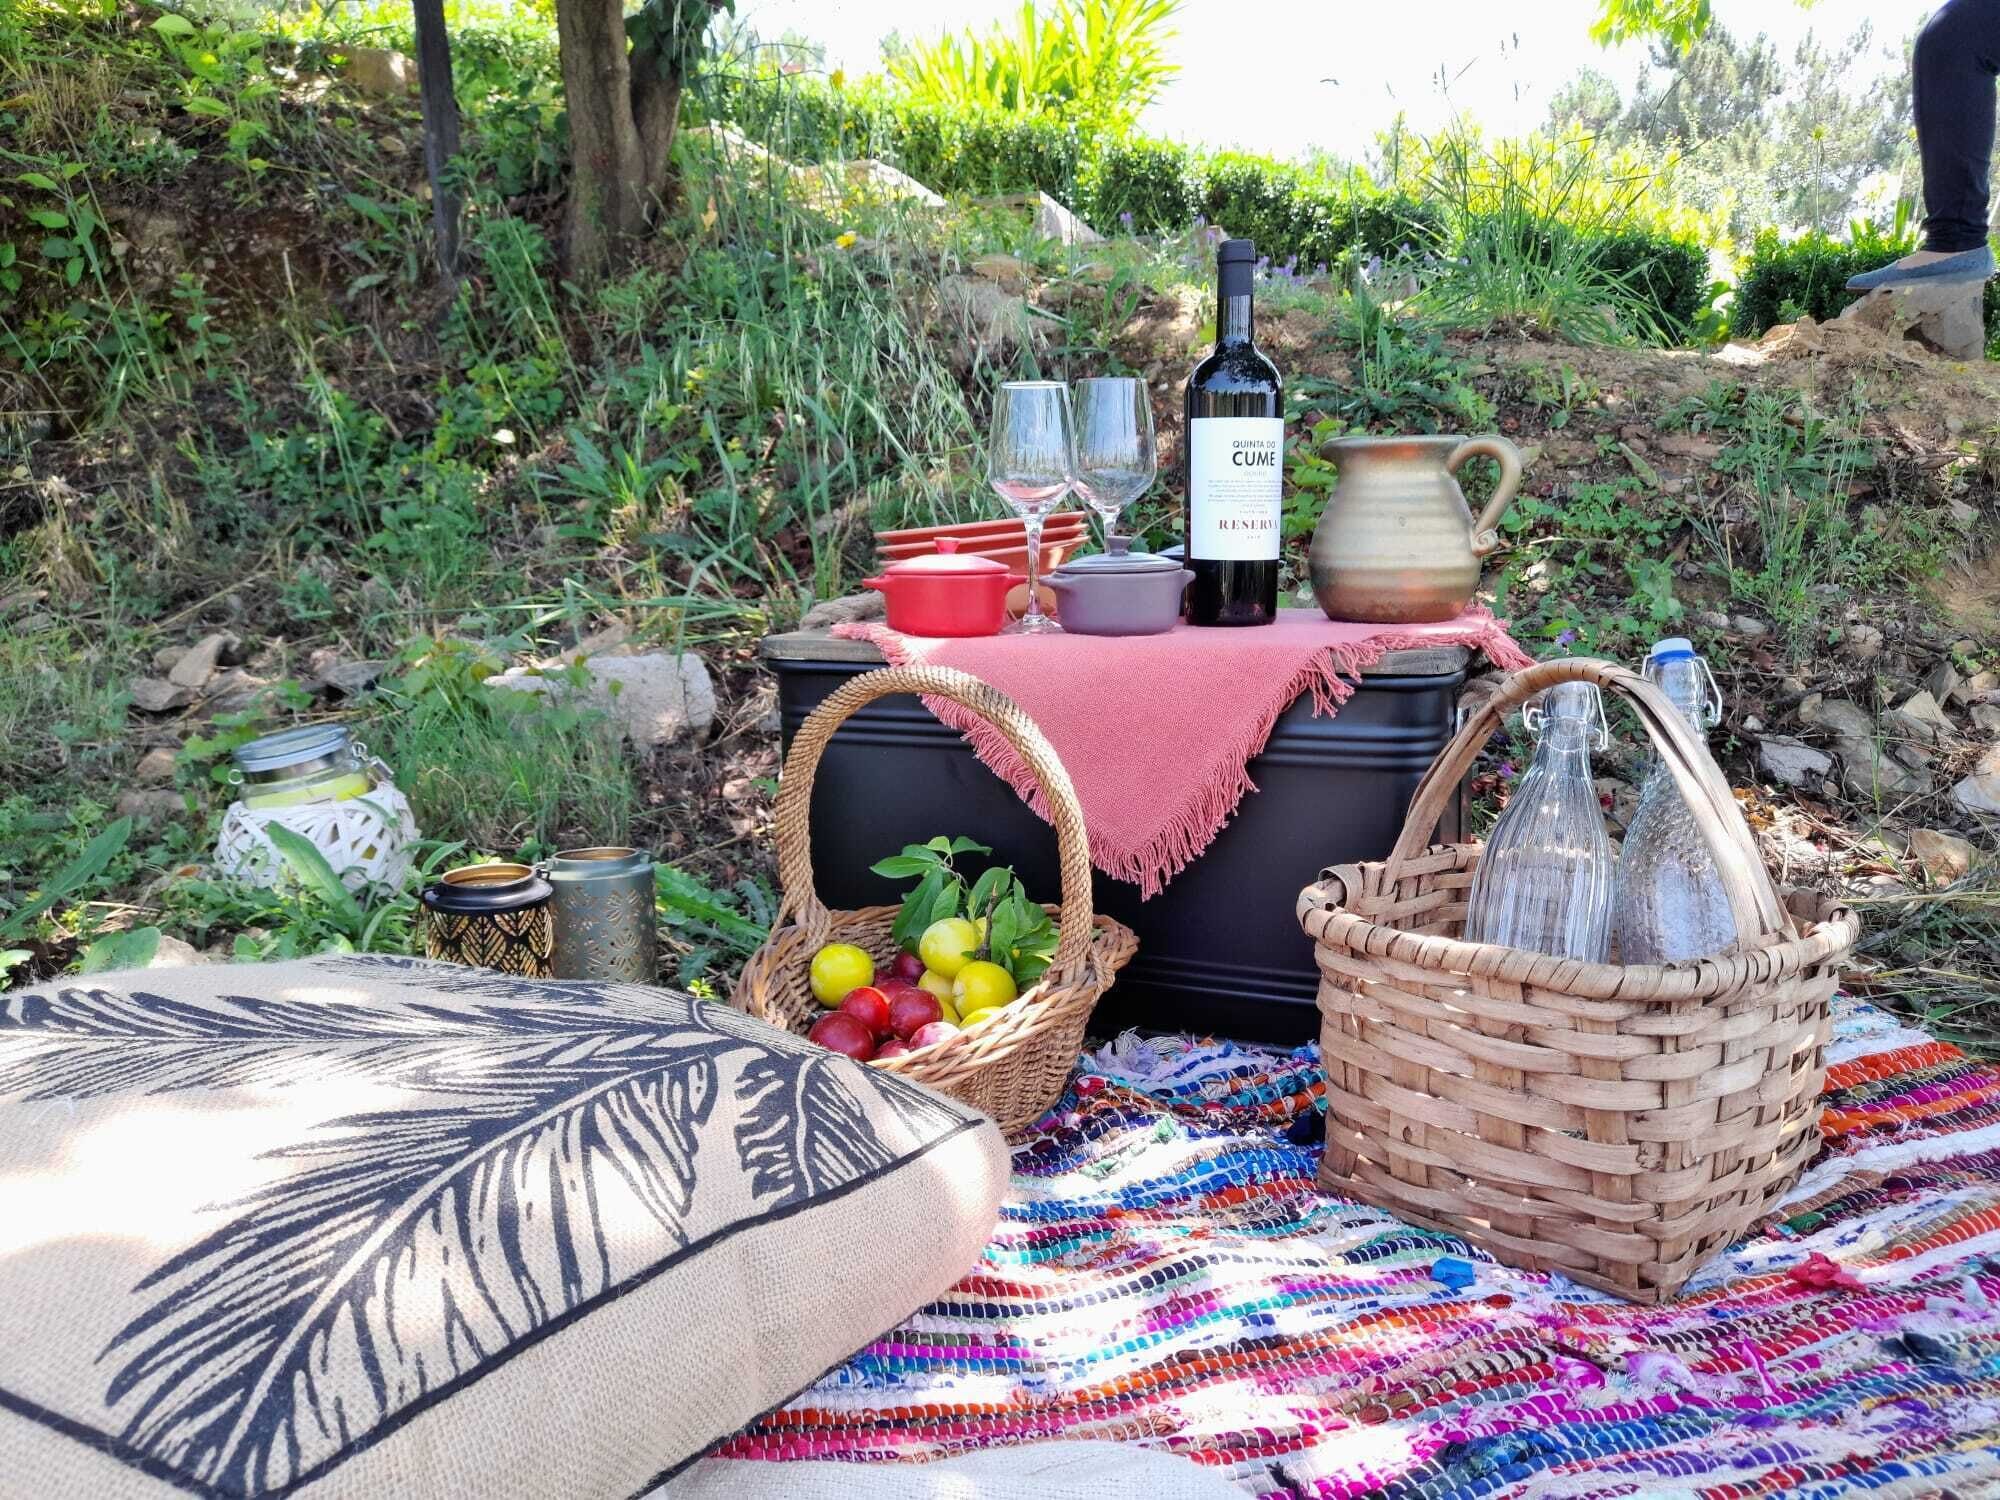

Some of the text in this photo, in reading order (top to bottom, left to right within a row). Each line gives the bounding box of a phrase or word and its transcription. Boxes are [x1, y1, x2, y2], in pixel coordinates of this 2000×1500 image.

[1232, 440, 1275, 448] QUINTA DO
[1232, 451, 1275, 466] CUME
